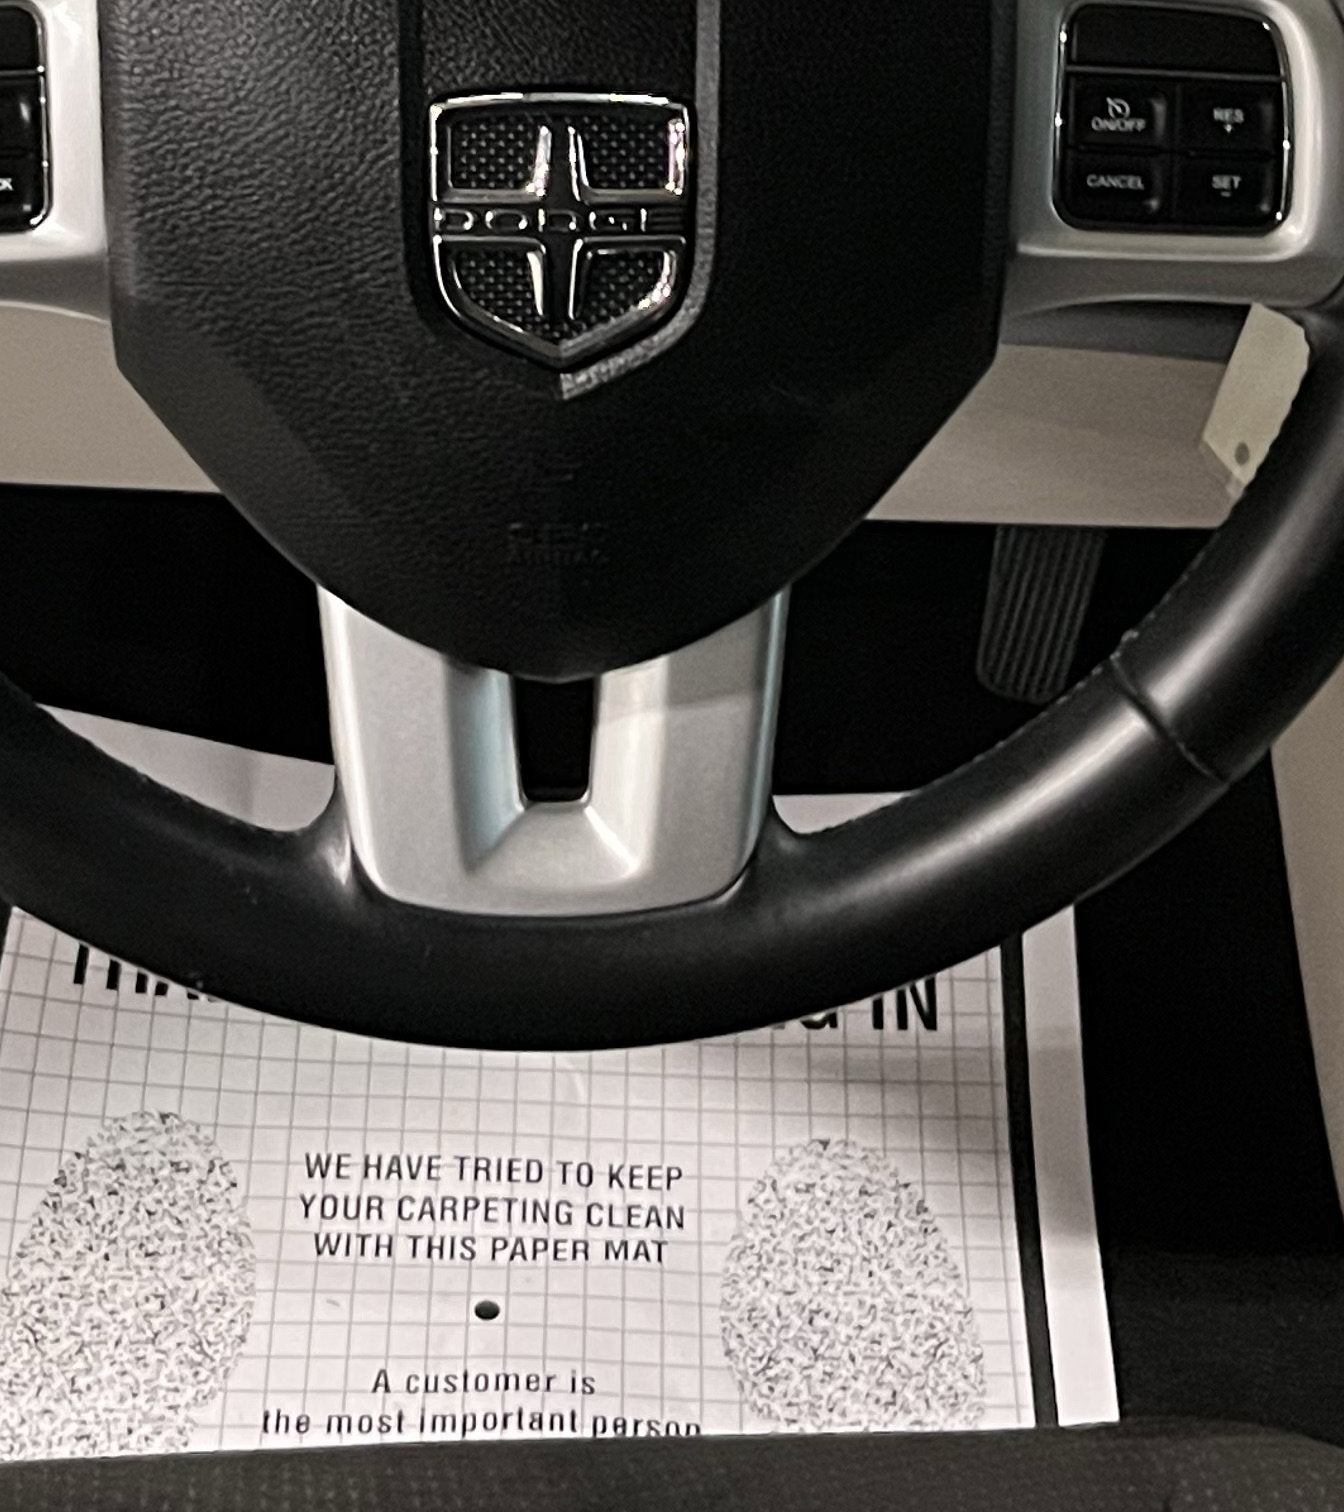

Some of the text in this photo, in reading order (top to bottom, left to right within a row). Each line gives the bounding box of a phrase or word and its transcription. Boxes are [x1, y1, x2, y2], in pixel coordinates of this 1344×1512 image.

[1086, 174, 1145, 190] CANCEL
[1212, 175, 1242, 190] SET
[305, 1152, 683, 1191] WE HAVE TRIED TO KEEP
[300, 1193, 685, 1230] YOUR CARPETING CLEAN
[313, 1232, 668, 1263] WITH THIS PAPER MAT
[371, 1368, 596, 1395] A customer is
[261, 1406, 702, 1439] the most important person
